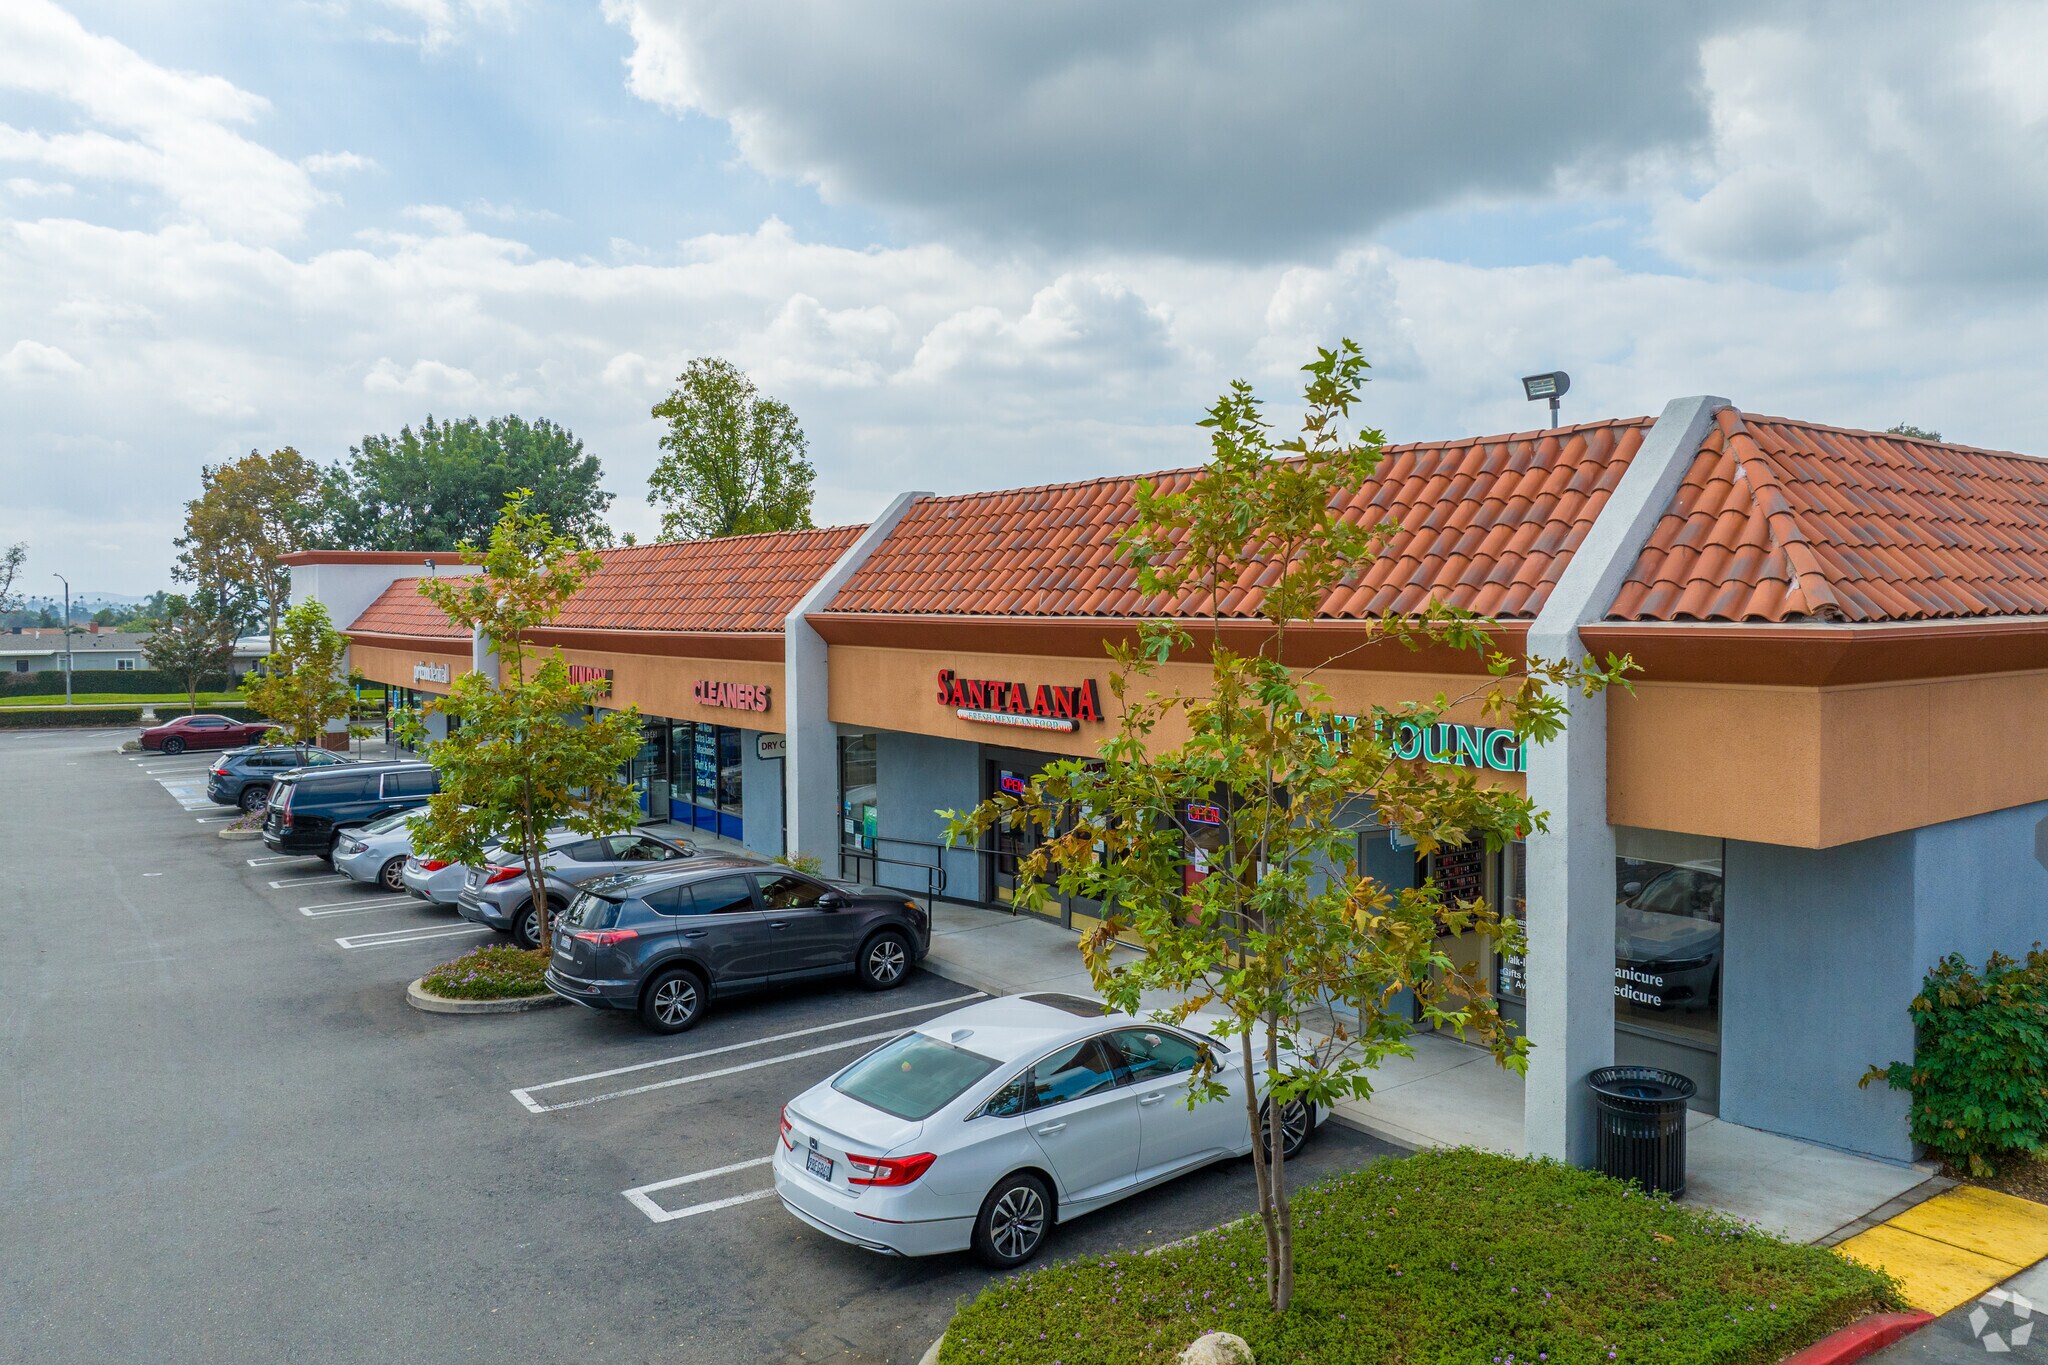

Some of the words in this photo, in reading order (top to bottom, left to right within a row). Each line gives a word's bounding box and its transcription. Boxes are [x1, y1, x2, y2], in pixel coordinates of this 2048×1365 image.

[692, 680, 769, 712] CLEANERS
[937, 669, 1027, 713] SANTA
[1031, 678, 1101, 721] ANA
[968, 711, 993, 722] FRESH
[995, 715, 1032, 726] MEXICAN
[1034, 719, 1059, 729] FOOD
[761, 740, 778, 751] DRY
[1002, 777, 1025, 793] OPEN
[1503, 967, 1522, 979] Gifts
[1615, 966, 1663, 987] anicure
[1613, 983, 1662, 1007] edicure
